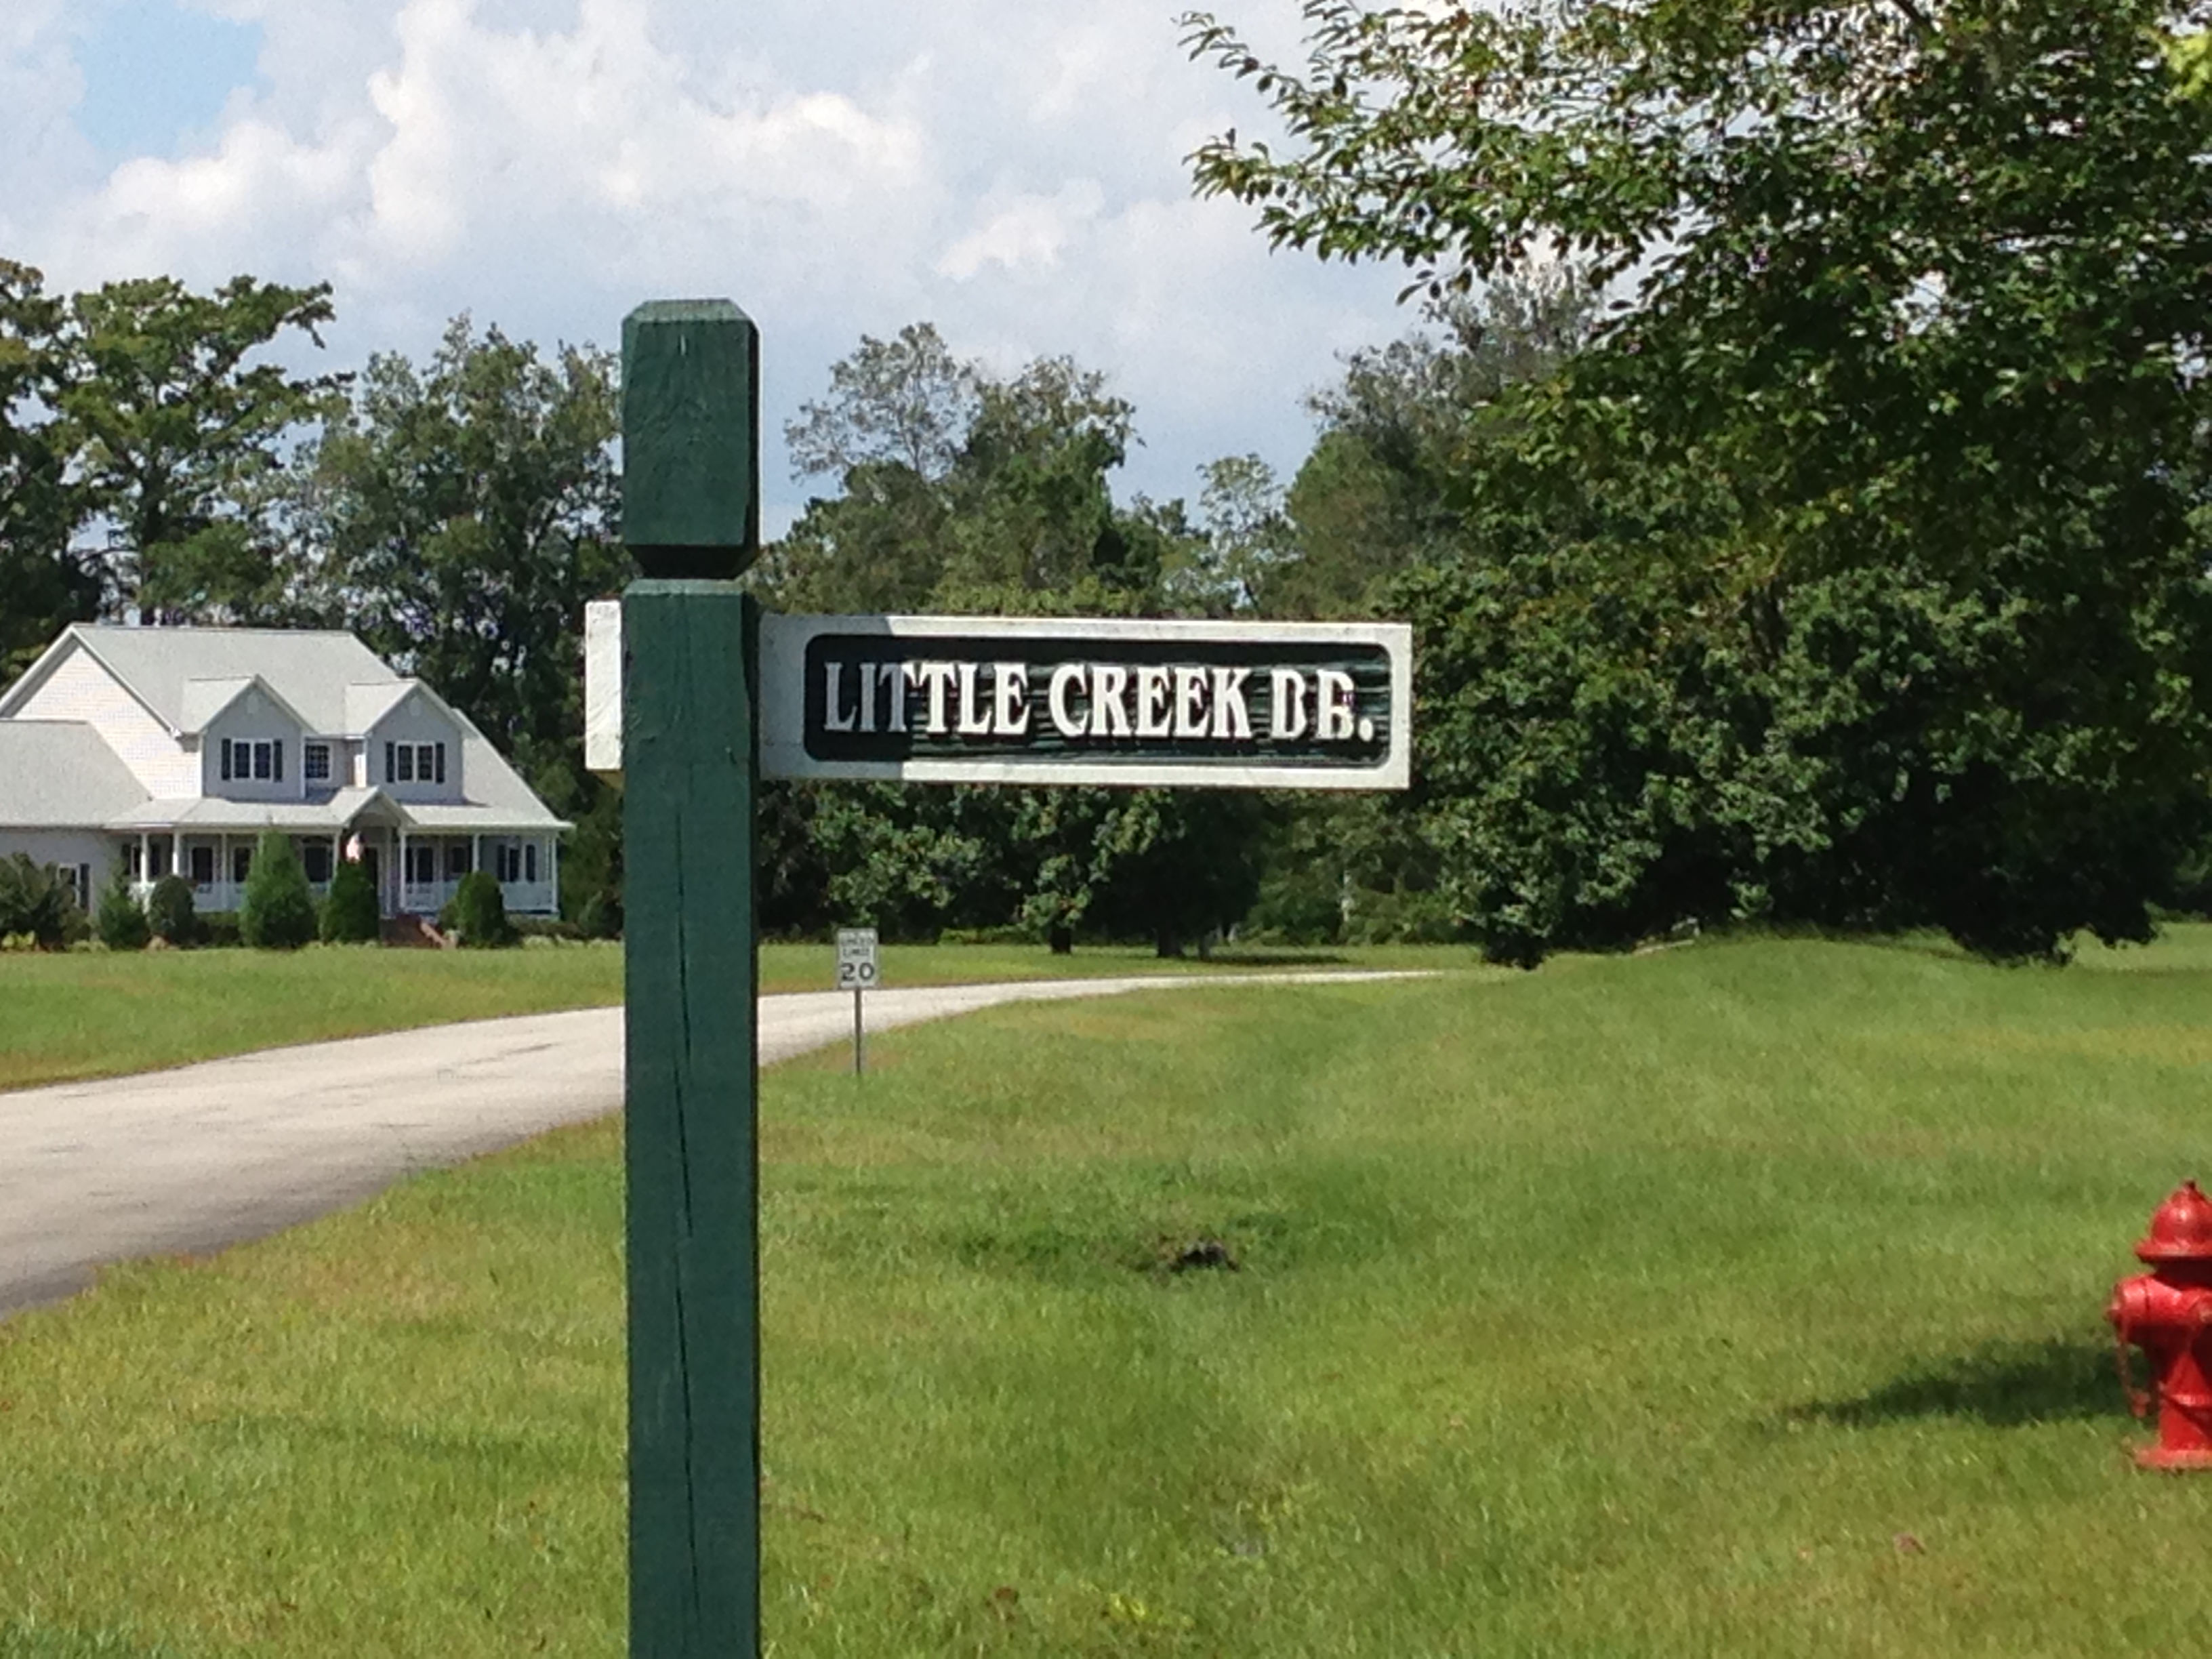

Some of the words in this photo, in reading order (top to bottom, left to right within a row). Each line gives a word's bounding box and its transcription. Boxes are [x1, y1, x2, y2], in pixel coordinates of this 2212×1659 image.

[824, 662, 1030, 734] LITTLE
[1048, 663, 1252, 738] CREEK
[841, 962, 875, 981] 20
